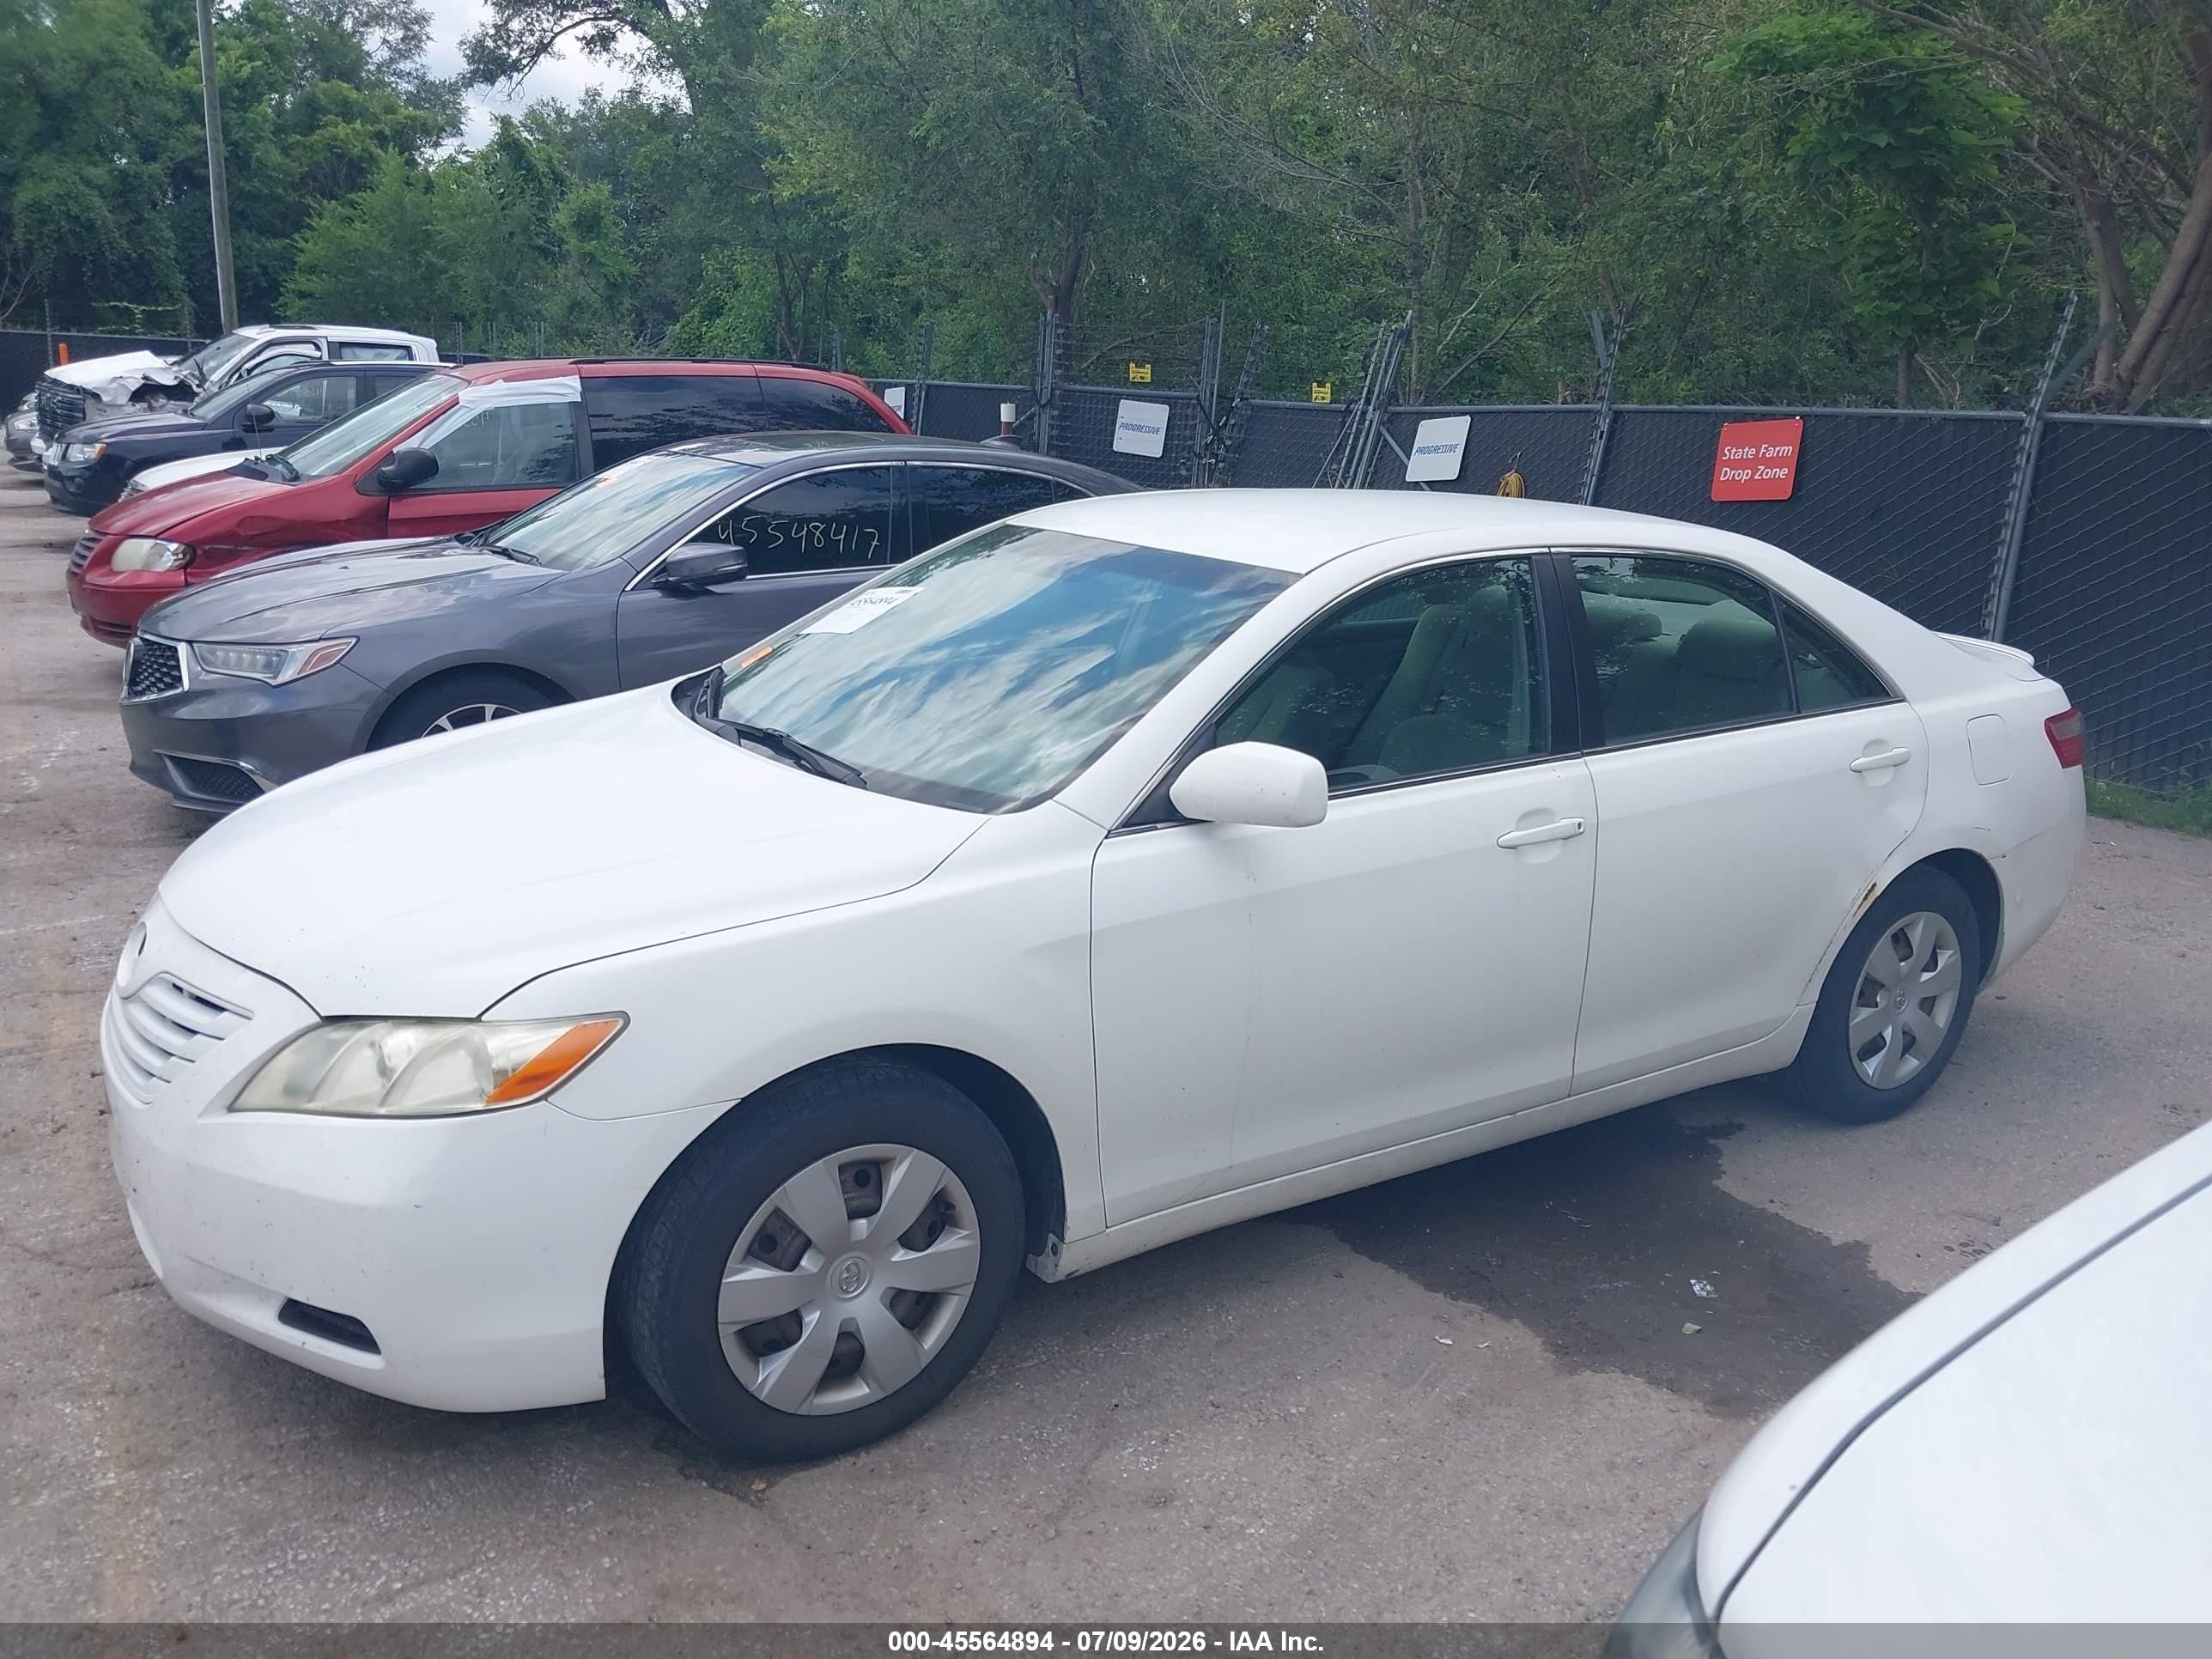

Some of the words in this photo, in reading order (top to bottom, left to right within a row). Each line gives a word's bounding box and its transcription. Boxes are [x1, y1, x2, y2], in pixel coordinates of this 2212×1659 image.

[1118, 422, 1161, 435] PROGRESSIVE
[1414, 443, 1460, 457] PROGRESSIVE
[1722, 446, 1756, 460] State
[1759, 444, 1793, 459] Farm
[1719, 466, 1752, 483] Drop
[1753, 465, 1789, 479] Zone
[718, 515, 881, 559] 45548417
